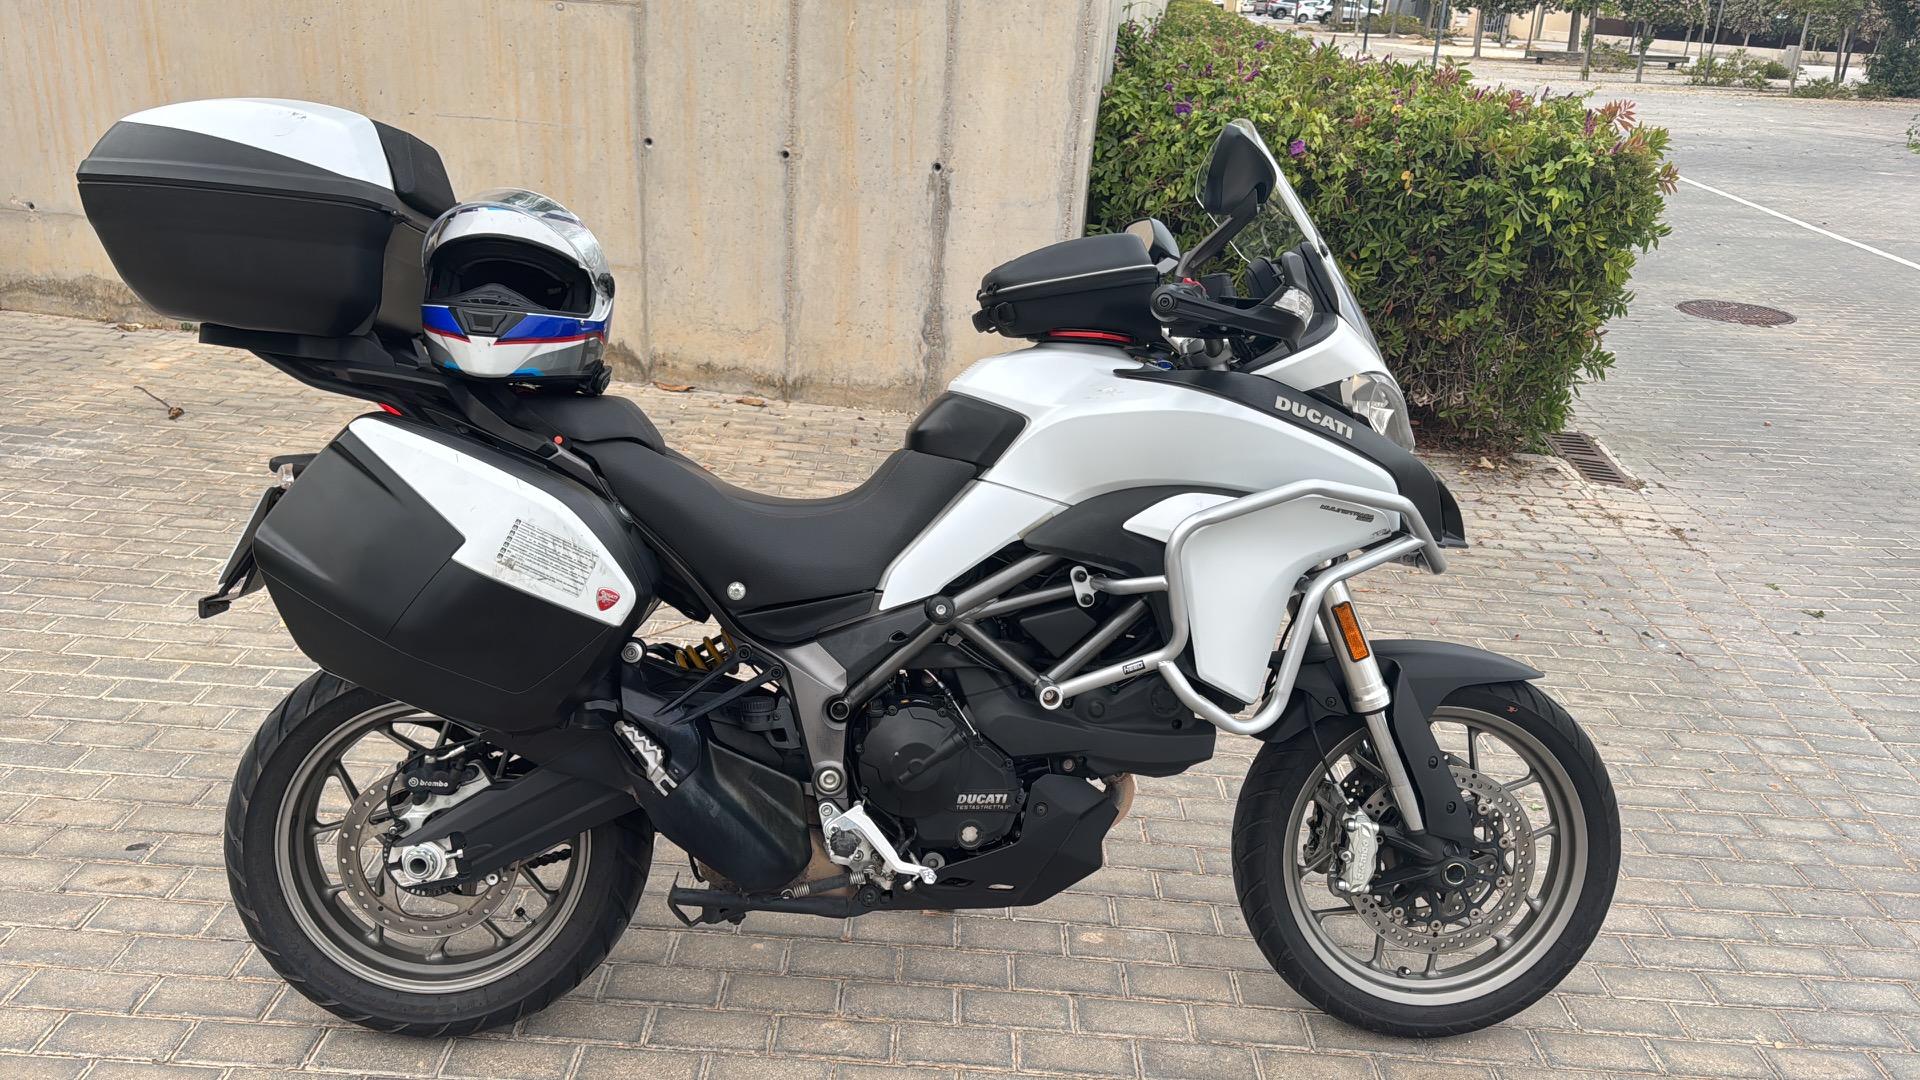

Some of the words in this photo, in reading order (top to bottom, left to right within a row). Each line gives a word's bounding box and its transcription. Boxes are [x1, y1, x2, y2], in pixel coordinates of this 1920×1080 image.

[1275, 396, 1353, 440] DUCATI
[419, 779, 448, 787] brembo
[957, 793, 1008, 804] DUCATI
